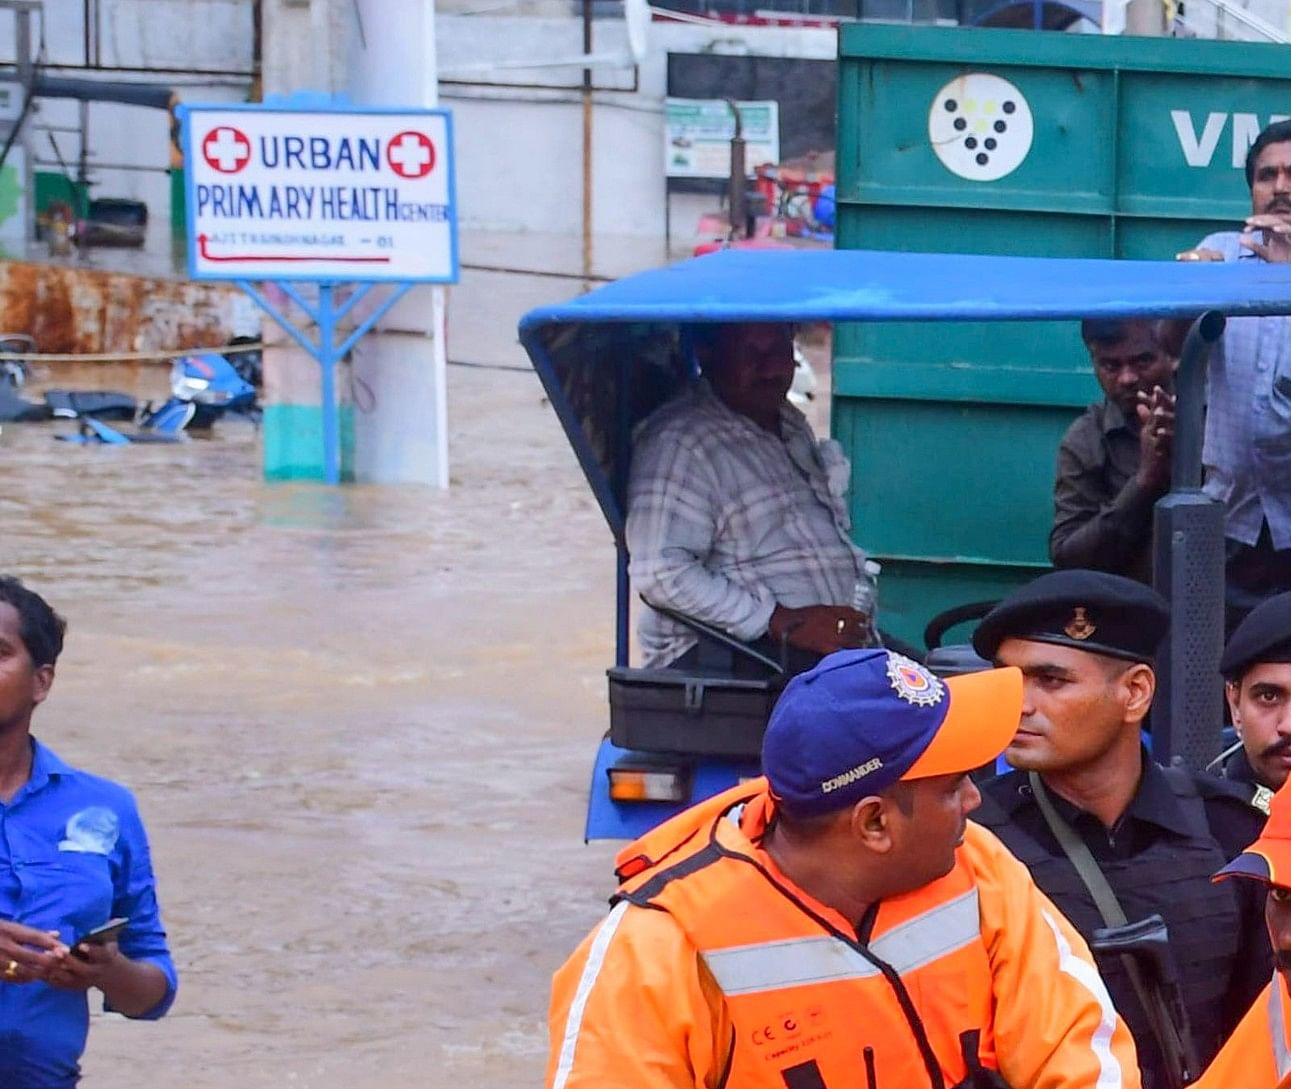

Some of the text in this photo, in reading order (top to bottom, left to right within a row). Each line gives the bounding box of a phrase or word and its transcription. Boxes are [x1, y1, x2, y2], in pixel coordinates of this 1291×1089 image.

[260, 136, 381, 171] URBAN
[196, 185, 318, 220] PRIMARY
[320, 187, 398, 221] HEALTH
